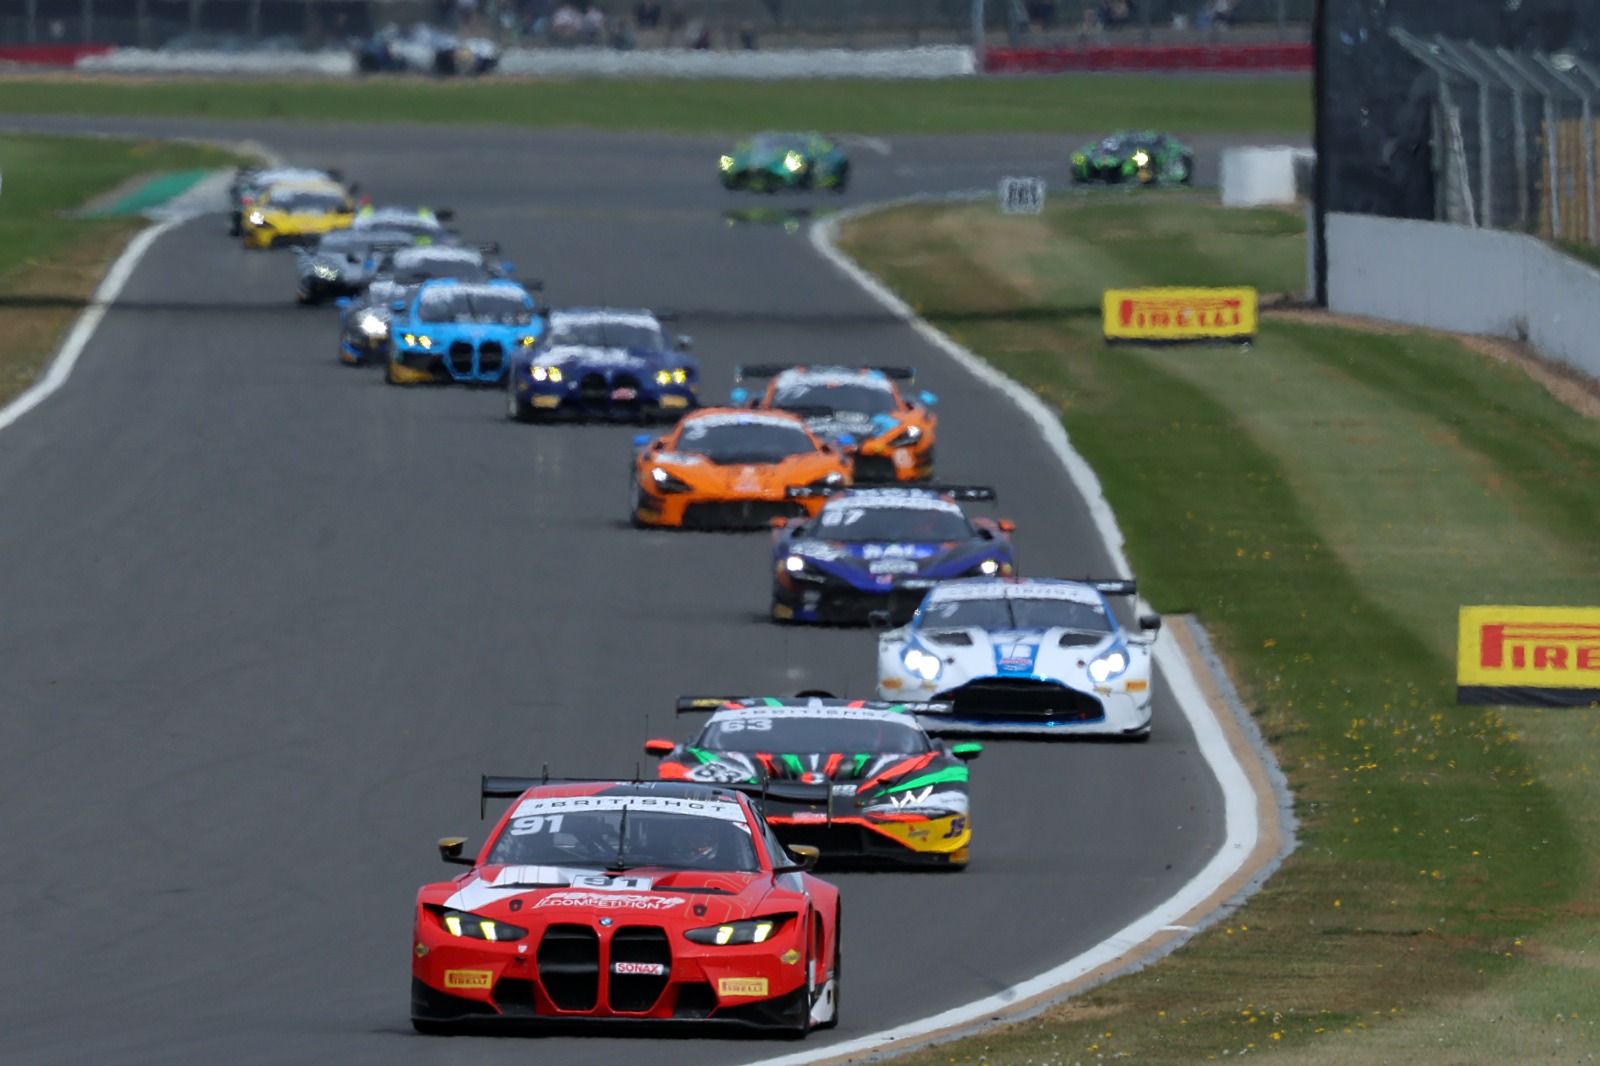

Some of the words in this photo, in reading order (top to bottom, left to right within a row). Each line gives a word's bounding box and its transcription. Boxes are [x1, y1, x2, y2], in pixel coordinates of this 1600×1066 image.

[1120, 299, 1240, 327] PIRELLI
[721, 719, 773, 733] 63
[534, 798, 724, 812] #BRITISHGT
[510, 815, 564, 835] 91
[549, 899, 661, 910] COMPETITION
[618, 963, 659, 975] SONAX
[721, 981, 763, 993] PIRELLI
